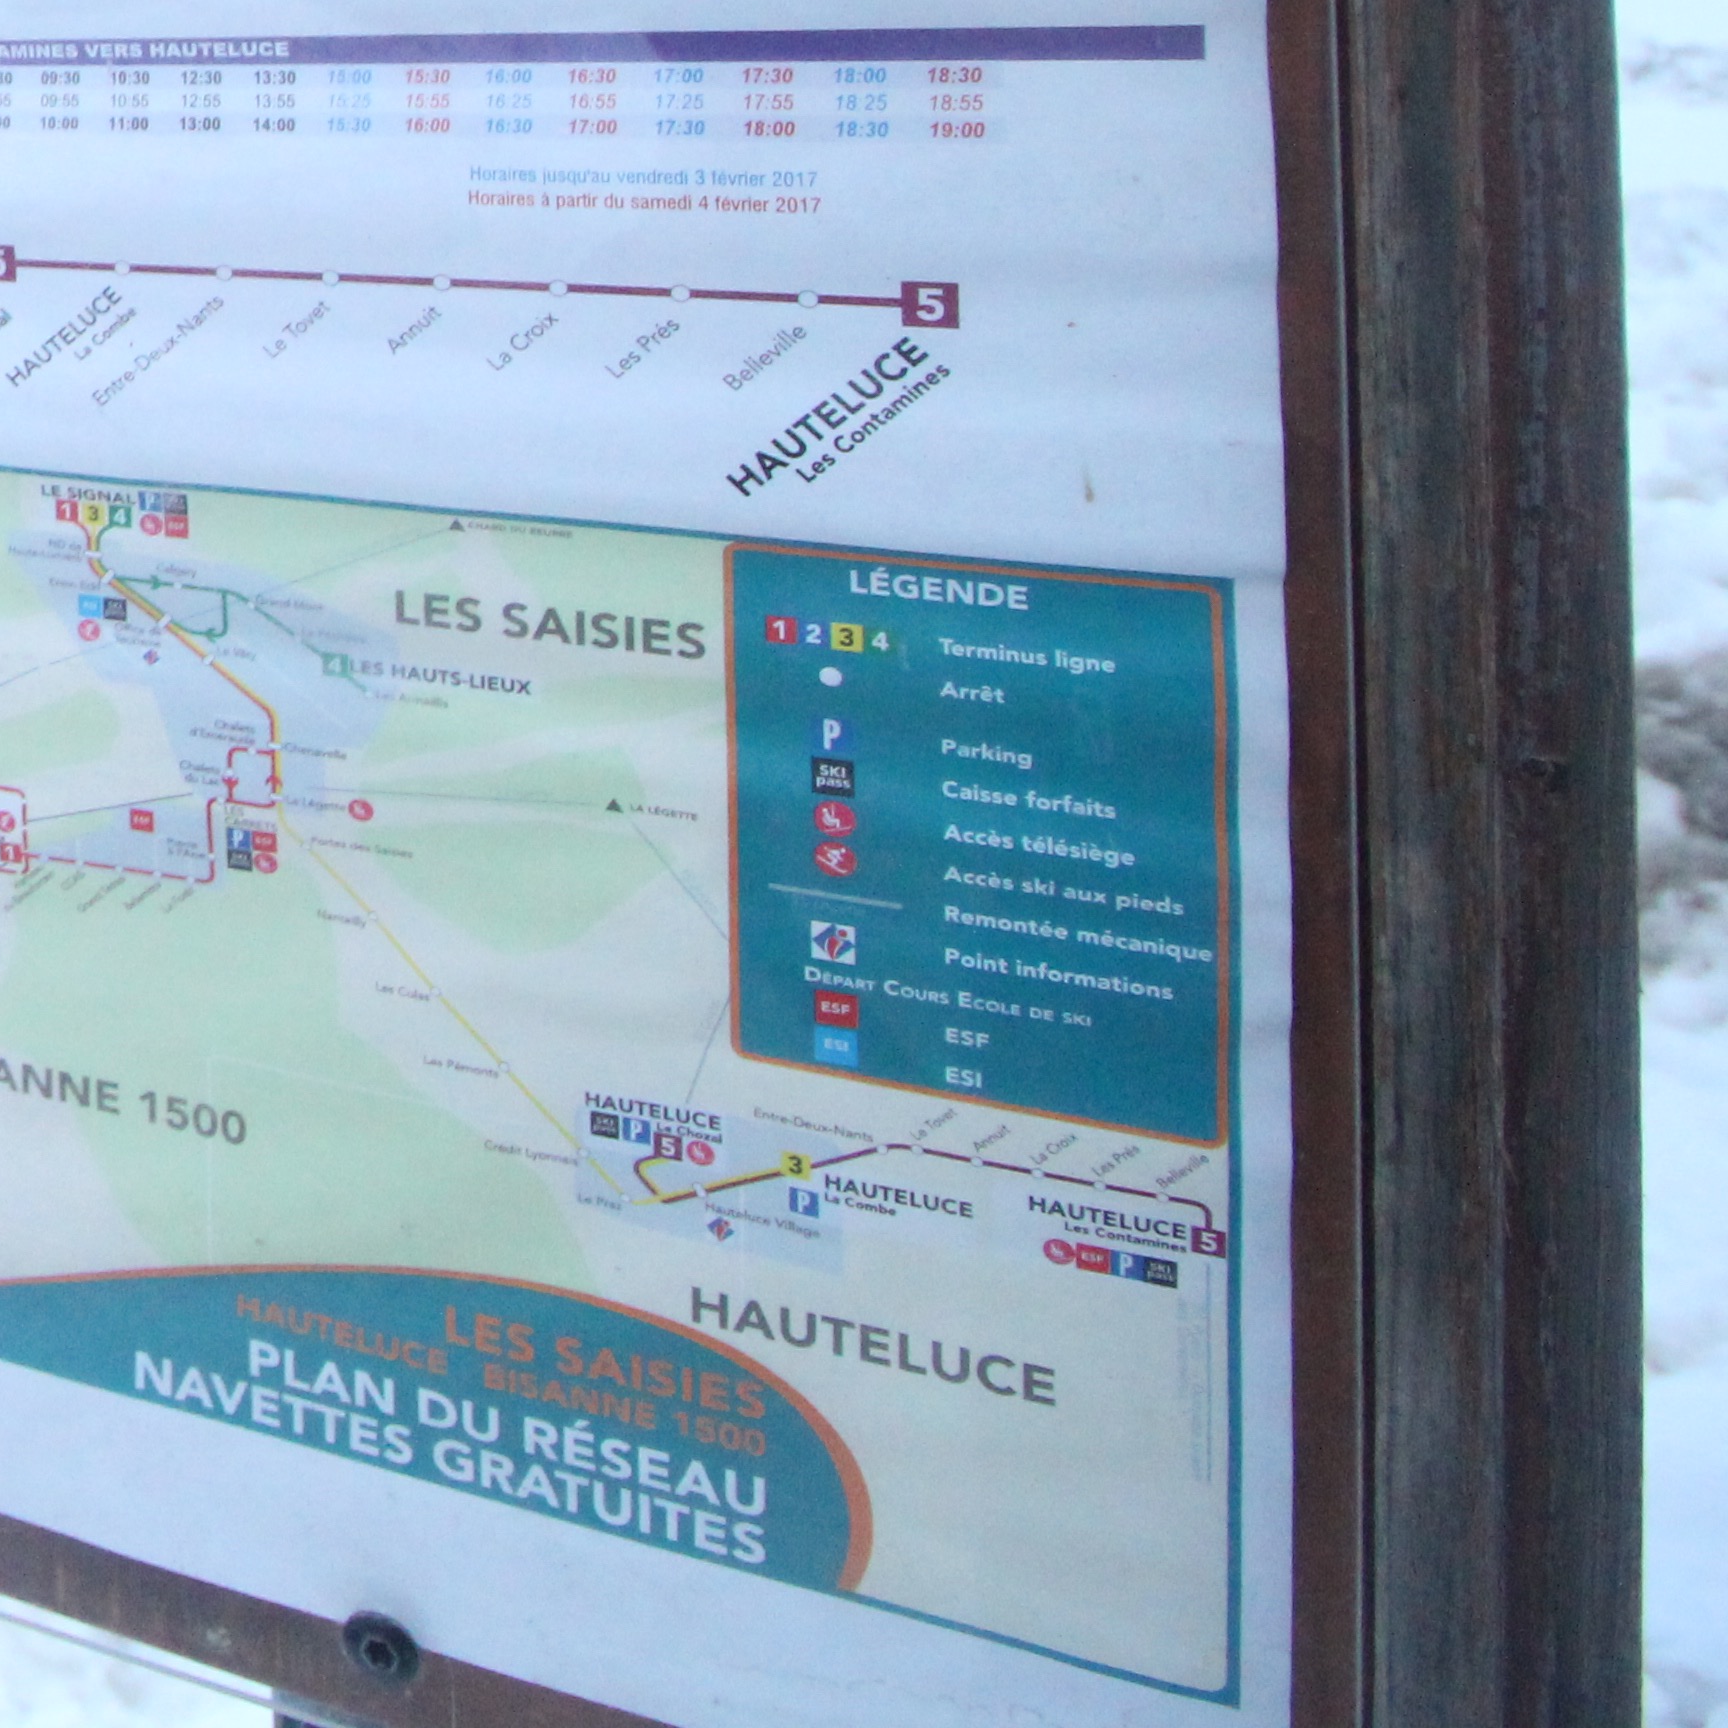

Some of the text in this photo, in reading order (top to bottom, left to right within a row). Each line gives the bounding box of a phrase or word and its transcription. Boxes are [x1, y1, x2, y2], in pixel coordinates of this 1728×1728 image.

[85, 42, 143, 59] VERS
[149, 41, 289, 58] HAUTELUCE
[569, 118, 985, 139] 17:00 17:30 18:00 18:30 19:00
[470, 166, 818, 188] Horaires vendredi février 2017
[468, 191, 822, 214] Horaires partir du samedi février 2017
[88, 305, 137, 348] Combe
[916, 288, 945, 321] 5
[5, 284, 123, 387] HAUTELUCE
[91, 293, 225, 408] Entre-Deux-Nants
[261, 298, 333, 360] Le Tovet
[386, 305, 443, 355] Annuit
[486, 311, 560, 373] La Croix
[604, 315, 682, 380] Les Prés
[722, 322, 809, 393] Belleville
[725, 335, 929, 498] HAUTELUCE
[796, 360, 952, 484] Les Contamines
[68, 486, 136, 505] SIGNAL
[849, 566, 1029, 610] LÉGENDE
[395, 590, 707, 659] LES SAISIES
[391, 662, 532, 695] HAUTS-LIEUX
[938, 637, 1117, 676] Terminus ligne
[940, 681, 1005, 705] Arrêt
[941, 738, 1033, 770] Parking
[942, 780, 1117, 821] Caisse forfaits
[944, 823, 1136, 868] Accès télésiège
[944, 866, 1184, 917] Accès ski aux pieds
[944, 905, 1213, 963] Remontée mécanique
[944, 948, 1174, 1001] Point informations
[945, 1027, 990, 1049] ESF
[945, 1066, 983, 1089] ESI
[139, 1090, 247, 1146] 1500
[584, 1092, 721, 1131] HAUTELUCE
[753, 1107, 874, 1143] Entre-Deux-Nants
[677, 1125, 723, 1145] Chozal
[1156, 1153, 1210, 1189] Belleville
[824, 1173, 974, 1219] HAUTELUCE
[844, 1196, 897, 1218] Combe
[1027, 1194, 1187, 1240] HAUTELUCE
[704, 1201, 821, 1239] Hauteluce Village
[1094, 1225, 1188, 1255] Contamines
[446, 1305, 766, 1421] LES SAISIES
[690, 1285, 1056, 1406] HAUTELUCE
[235, 1293, 766, 1456] HAUTELUCE BISANNE 1500
[249, 1339, 767, 1517] PLAN DU RÉSEAU
[135, 1351, 767, 1564] NAVETTES GRATUITES
